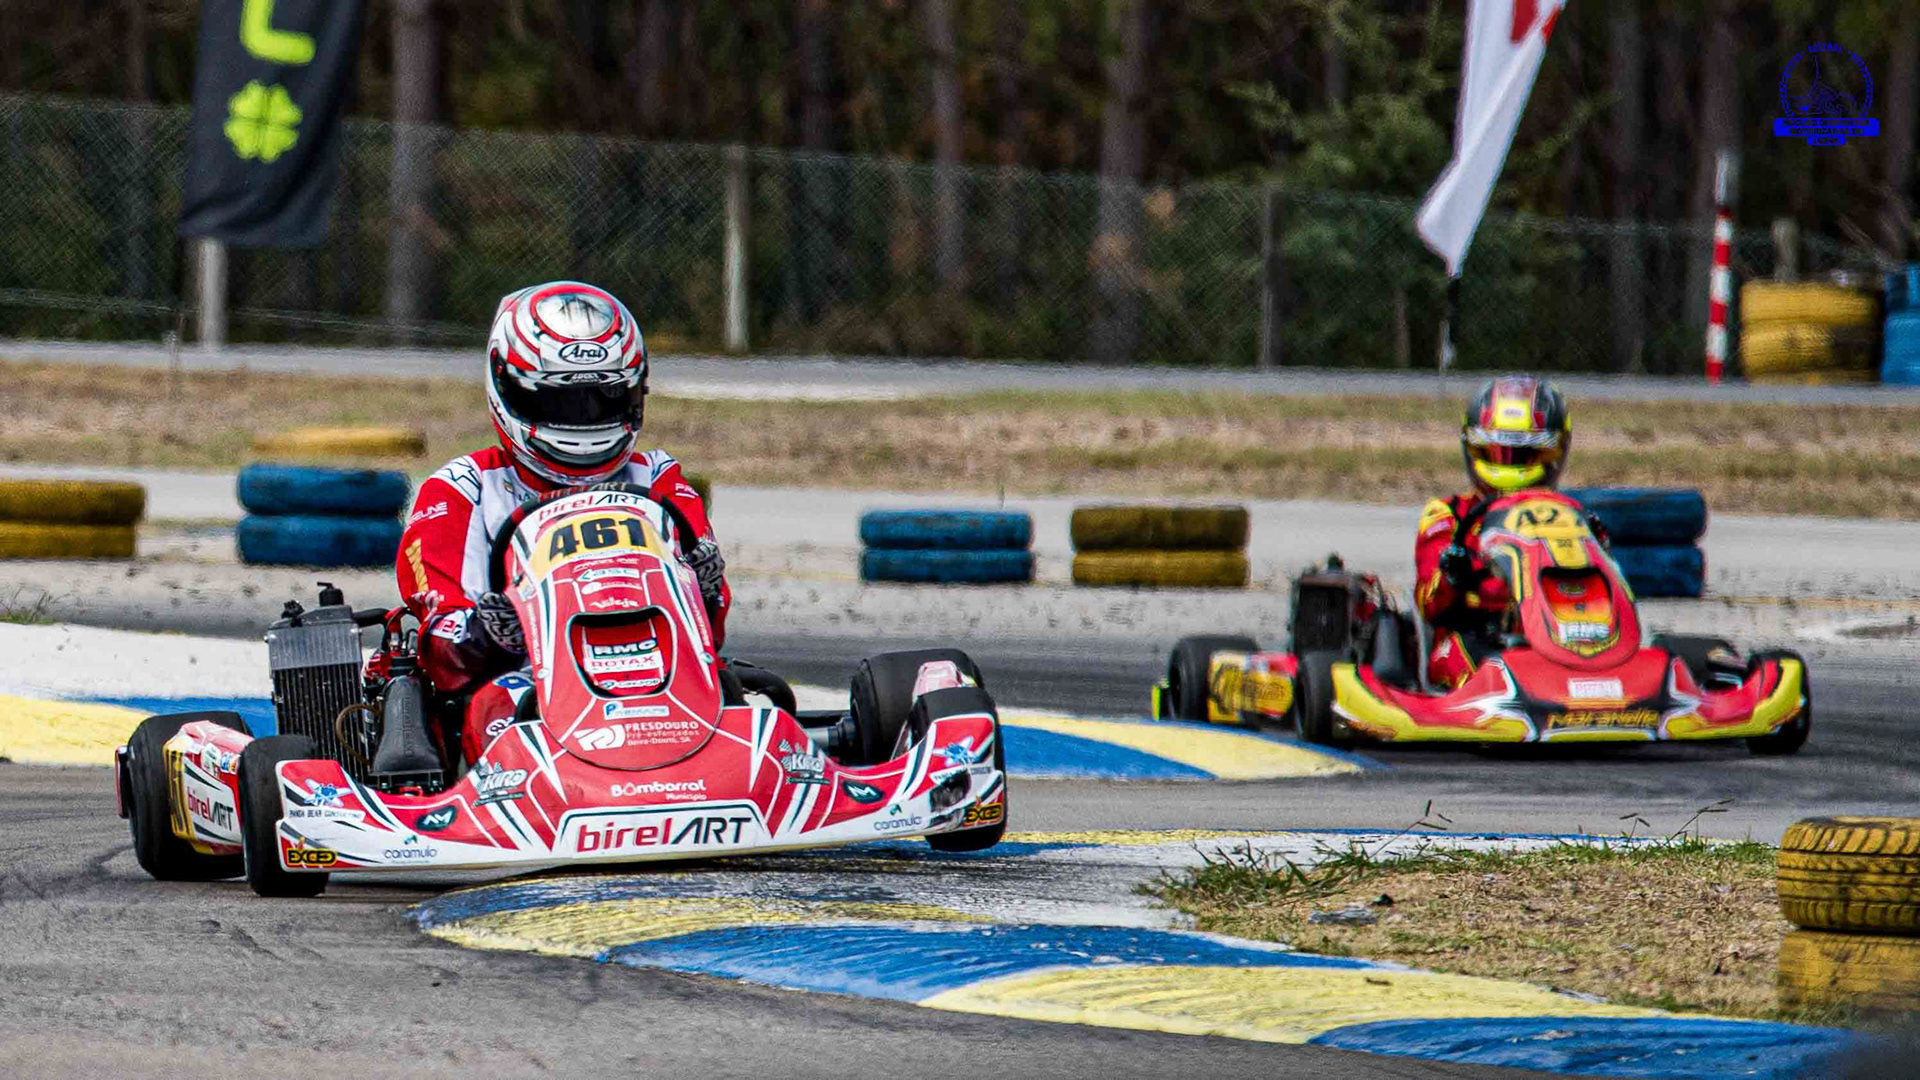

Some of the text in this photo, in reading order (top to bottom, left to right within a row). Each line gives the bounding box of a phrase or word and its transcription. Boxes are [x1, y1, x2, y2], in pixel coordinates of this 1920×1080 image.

[563, 344, 602, 358] Arai
[549, 517, 648, 561] 461
[590, 655, 655, 667] ROTAX
[625, 720, 699, 732] PRESDOURO
[187, 785, 235, 831] birelART
[576, 817, 751, 853] birelART
